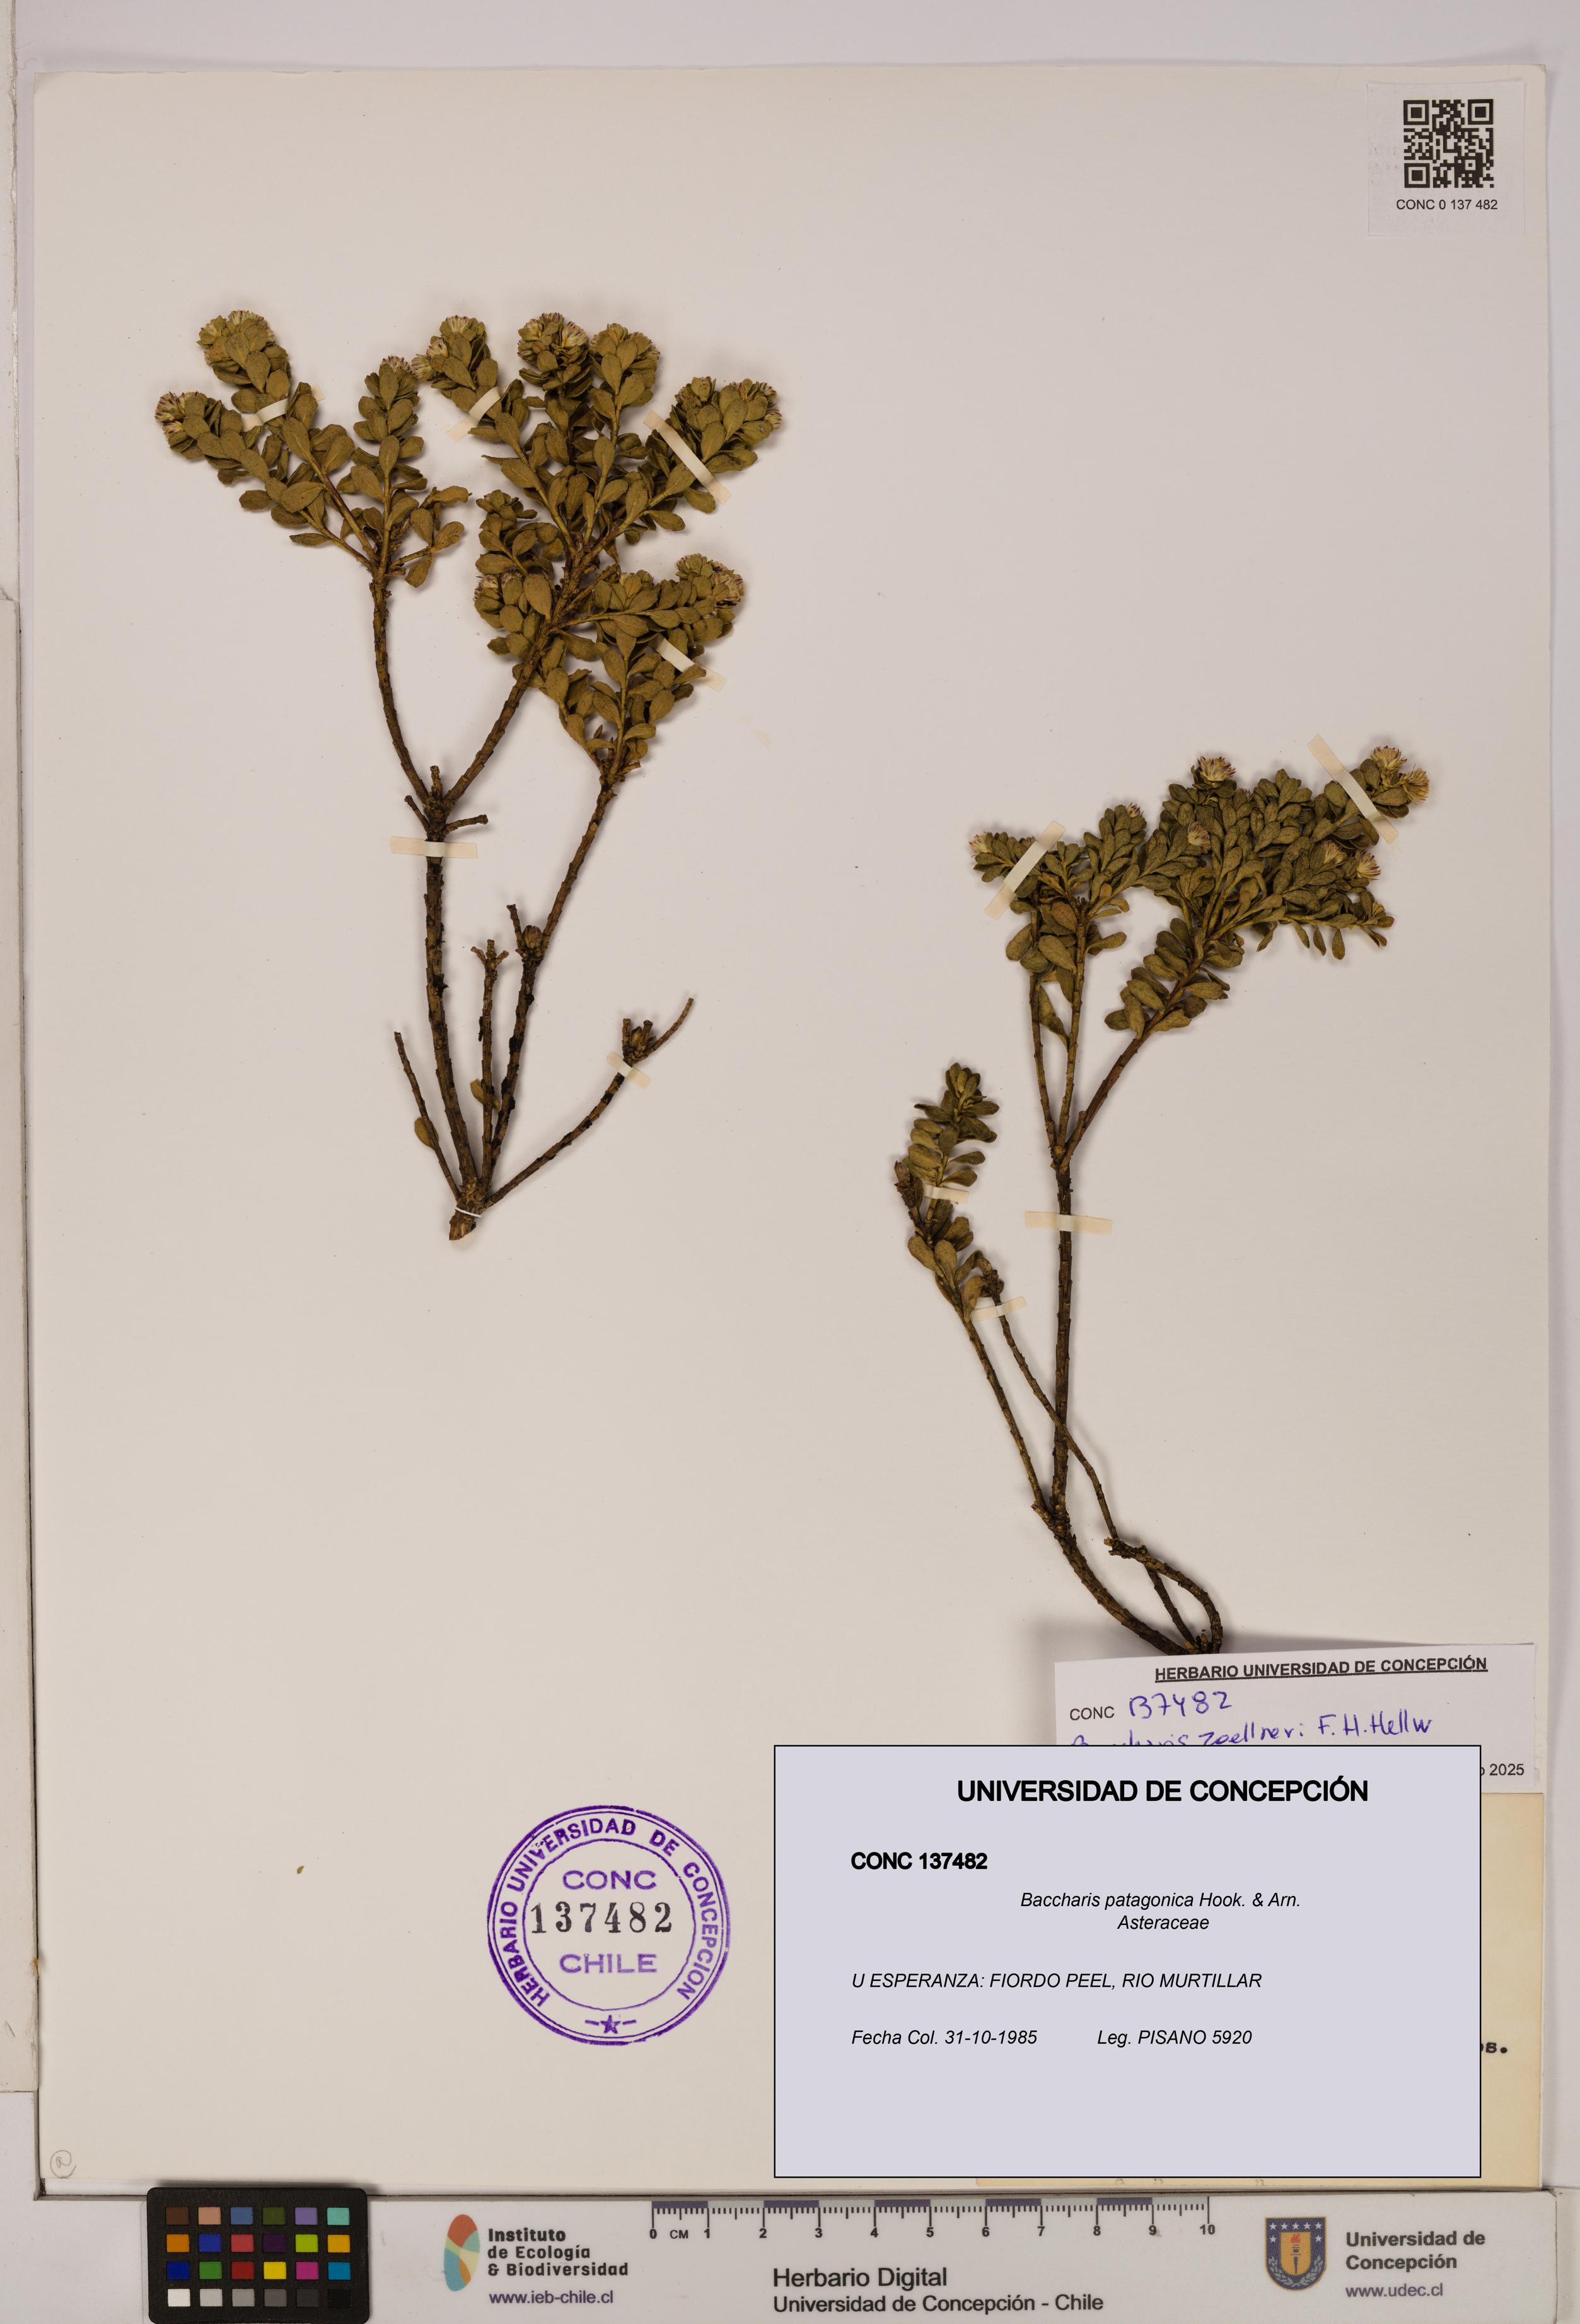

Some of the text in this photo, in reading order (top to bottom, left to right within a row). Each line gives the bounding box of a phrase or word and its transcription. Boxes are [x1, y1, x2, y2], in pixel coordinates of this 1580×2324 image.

[1396, 199, 1498, 211] CONC 0 137 482
[1155, 1655, 1487, 1682] HERBARIO UNIVERSIDAD DE CONCEPCIÓN
[1069, 1705, 1115, 1721] CONC
[1489, 1763, 1525, 1776] 2025
[562, 1870, 657, 1890] CONC
[500, 1817, 719, 2008] HERBARIO UNIVERSIDAD DE CONCEPCION
[531, 1900, 673, 1934] 137482
[559, 1953, 658, 1974] CHILE
[488, 2228, 566, 2242] Instituto
[649, 2224, 1216, 2240] 0 CM 1 2 3 4 5 6 7 8 9 10
[1346, 2230, 1486, 2247] Universidad de
[487, 2245, 591, 2262] de Ecología
[487, 2262, 629, 2277] & Biodiversidad
[1345, 2253, 1457, 2273] Concepción
[773, 2267, 947, 2292] Herbario Digital
[489, 2289, 613, 2304] www.ieb-chile.cl
[1345, 2282, 1443, 2298] www.udec.cl
[774, 2295, 886, 2313] Universidad
[892, 2295, 917, 2312] de
[922, 2294, 1035, 2315] Concepción
[1055, 2293, 1104, 2311] Chile
